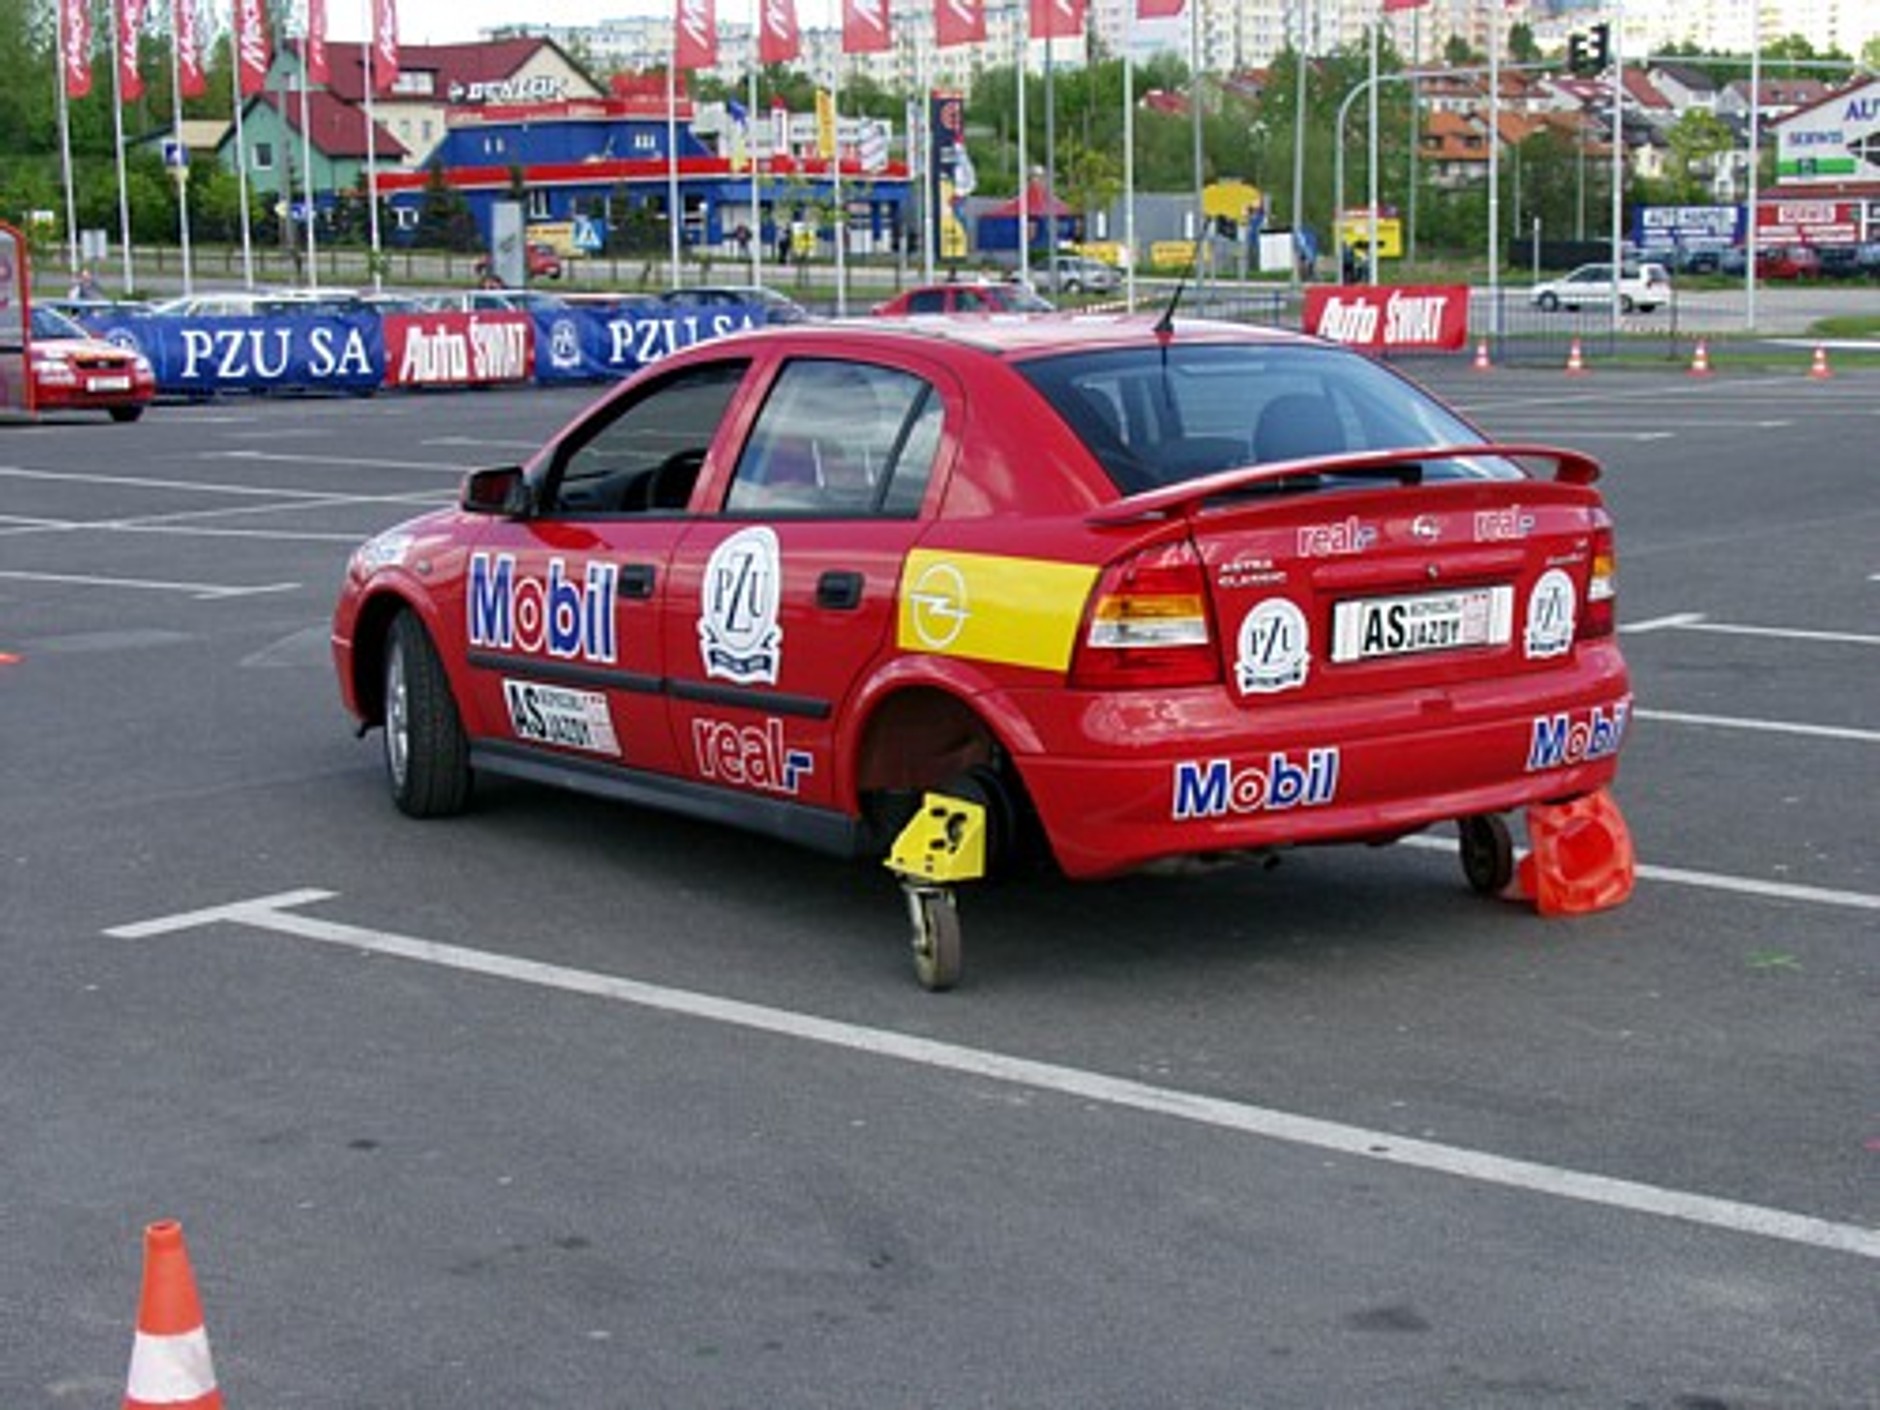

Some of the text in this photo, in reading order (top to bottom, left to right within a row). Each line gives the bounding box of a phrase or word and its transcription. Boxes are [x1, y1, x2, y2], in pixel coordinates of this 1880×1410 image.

[1317, 296, 1379, 344] Auto
[181, 327, 373, 379] PZU SA
[400, 322, 469, 382] Auto
[468, 552, 619, 663] Mobil
[1364, 604, 1407, 651] AS
[1173, 746, 1340, 821] Mobil
